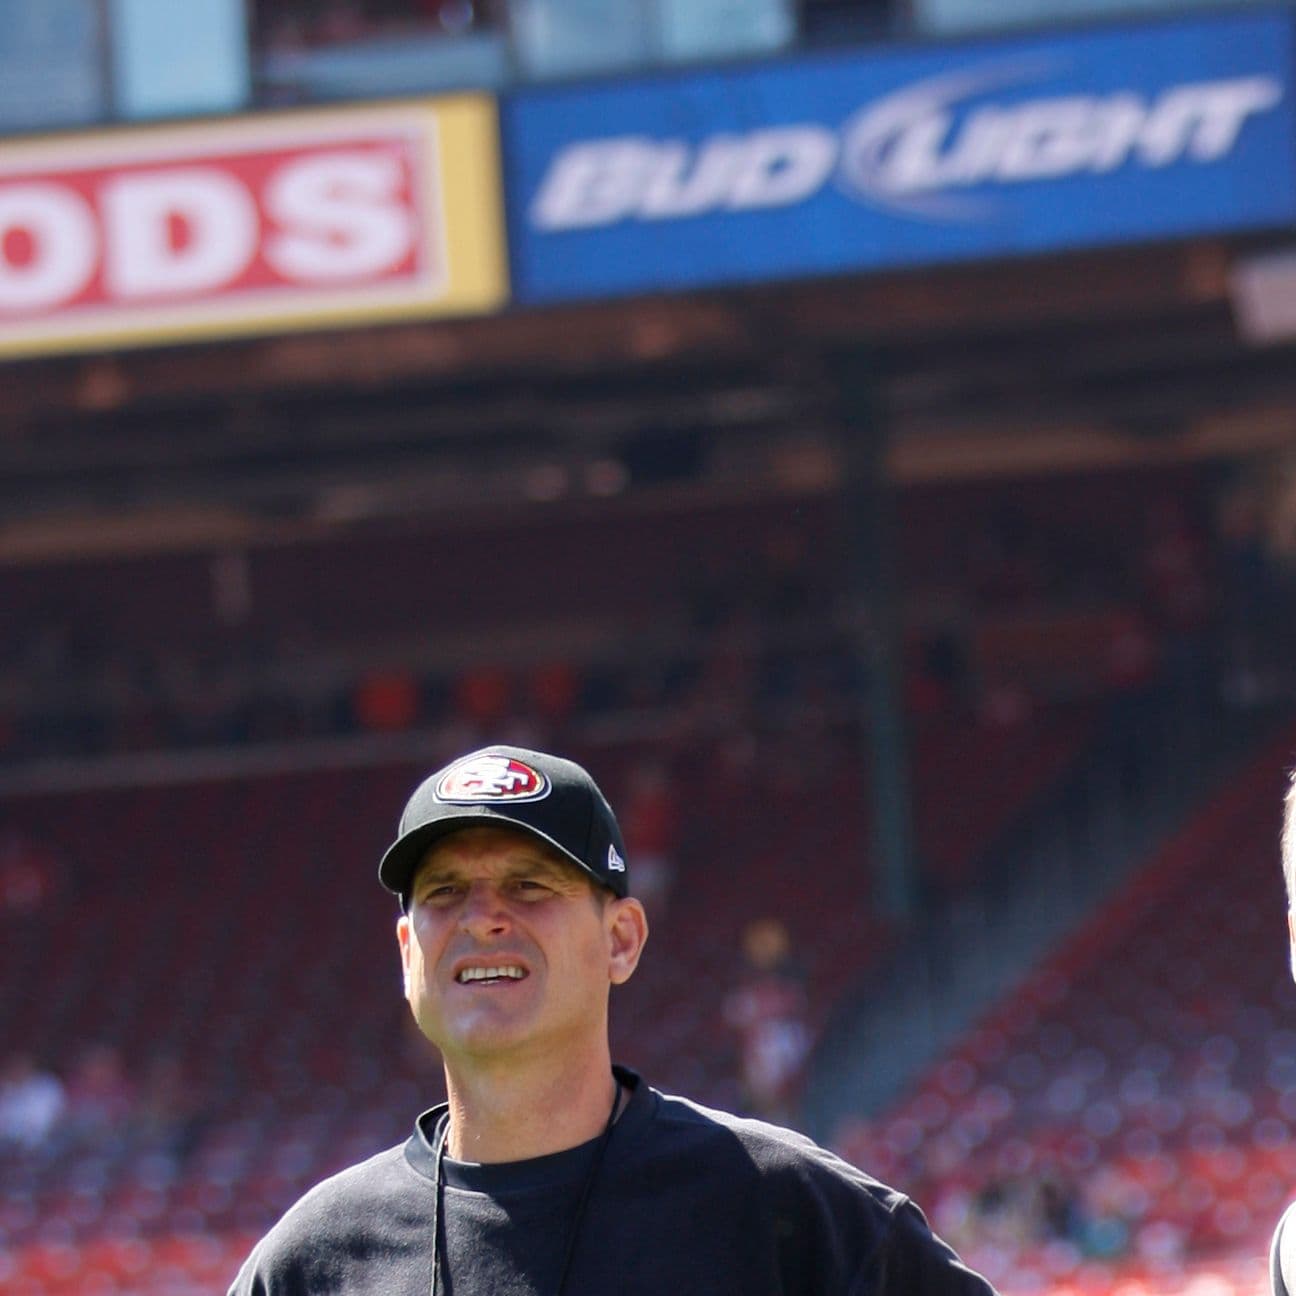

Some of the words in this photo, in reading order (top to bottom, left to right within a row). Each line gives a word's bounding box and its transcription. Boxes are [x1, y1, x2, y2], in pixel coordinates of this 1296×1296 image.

[0, 152, 414, 308] ODS
[530, 124, 840, 233] BUD
[864, 76, 1284, 198] LIGHT
